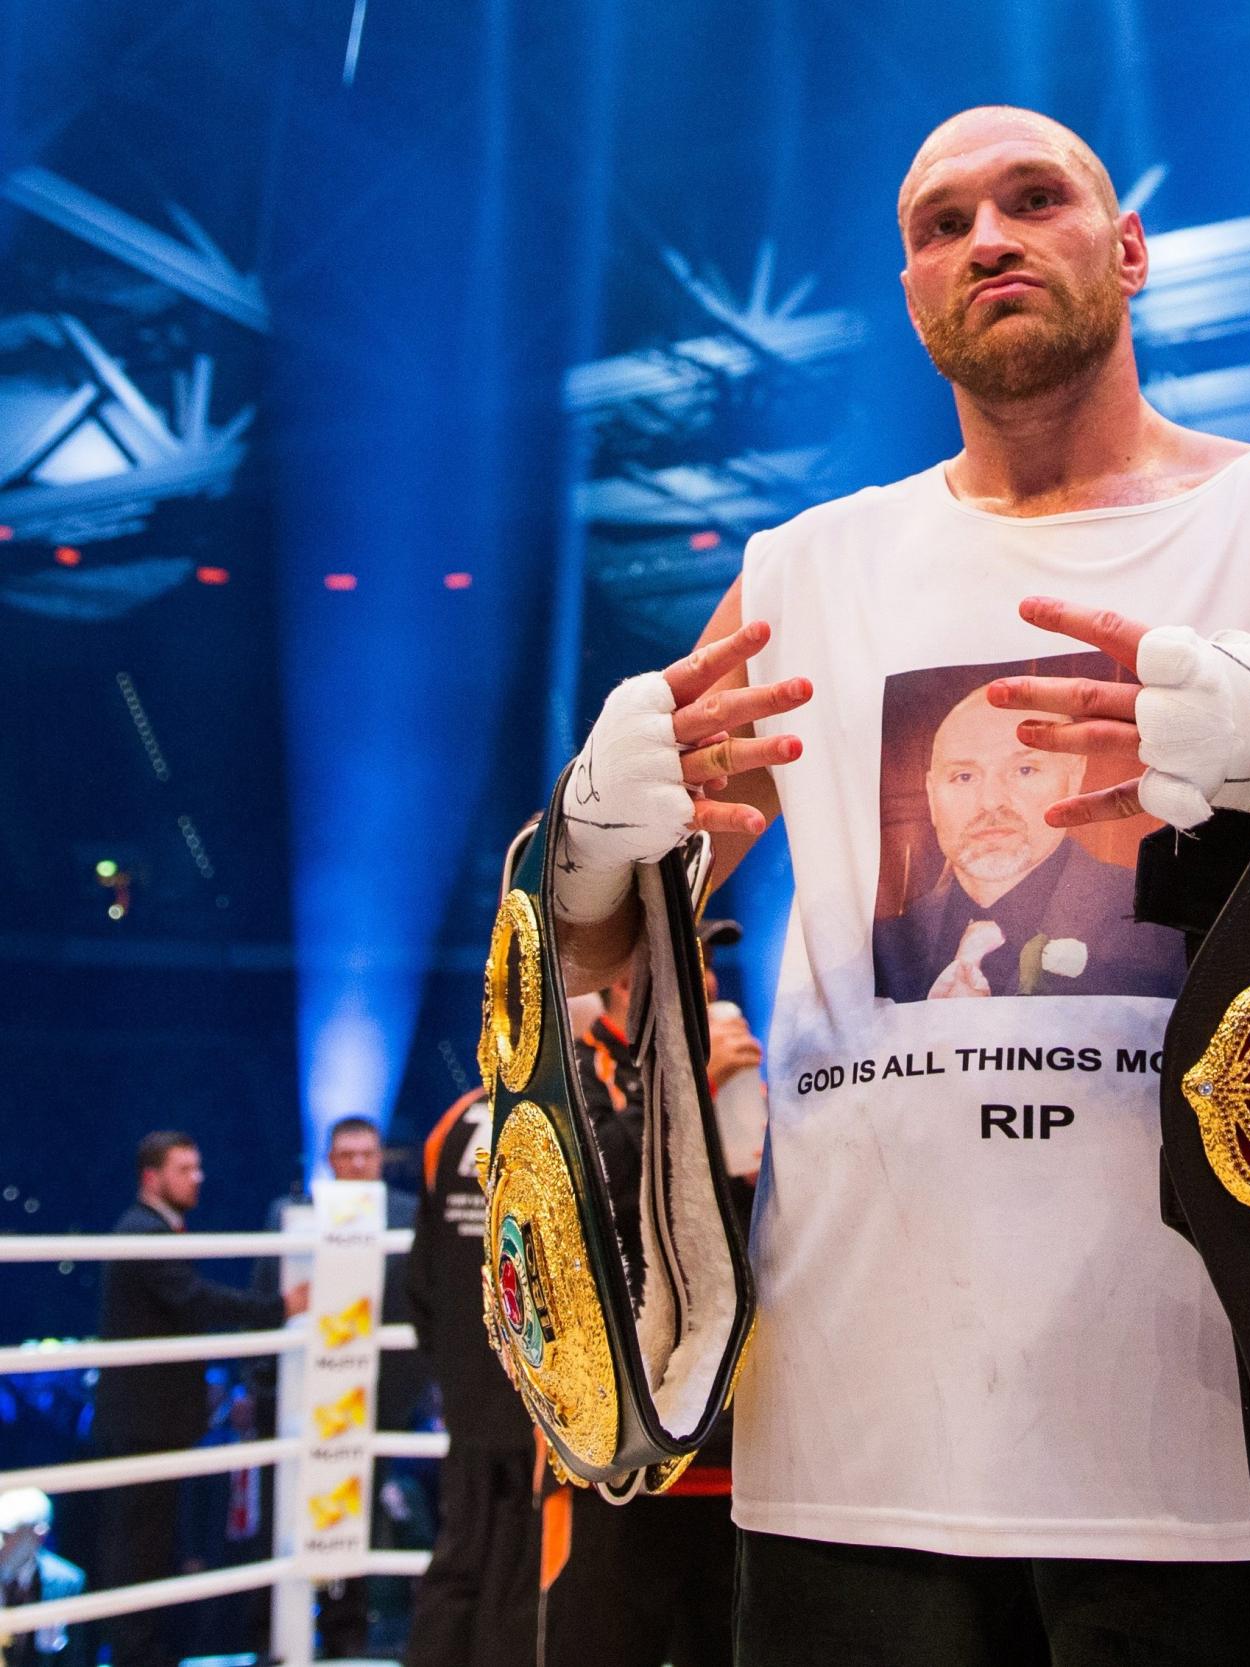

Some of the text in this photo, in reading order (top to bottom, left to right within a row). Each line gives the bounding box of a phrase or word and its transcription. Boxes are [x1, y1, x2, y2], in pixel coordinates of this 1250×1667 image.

[797, 1065, 845, 1096] GOD
[852, 1059, 876, 1085] IS
[881, 1051, 946, 1080] ALL
[955, 1046, 1103, 1072] THINGS
[980, 1104, 1075, 1140] RIP
